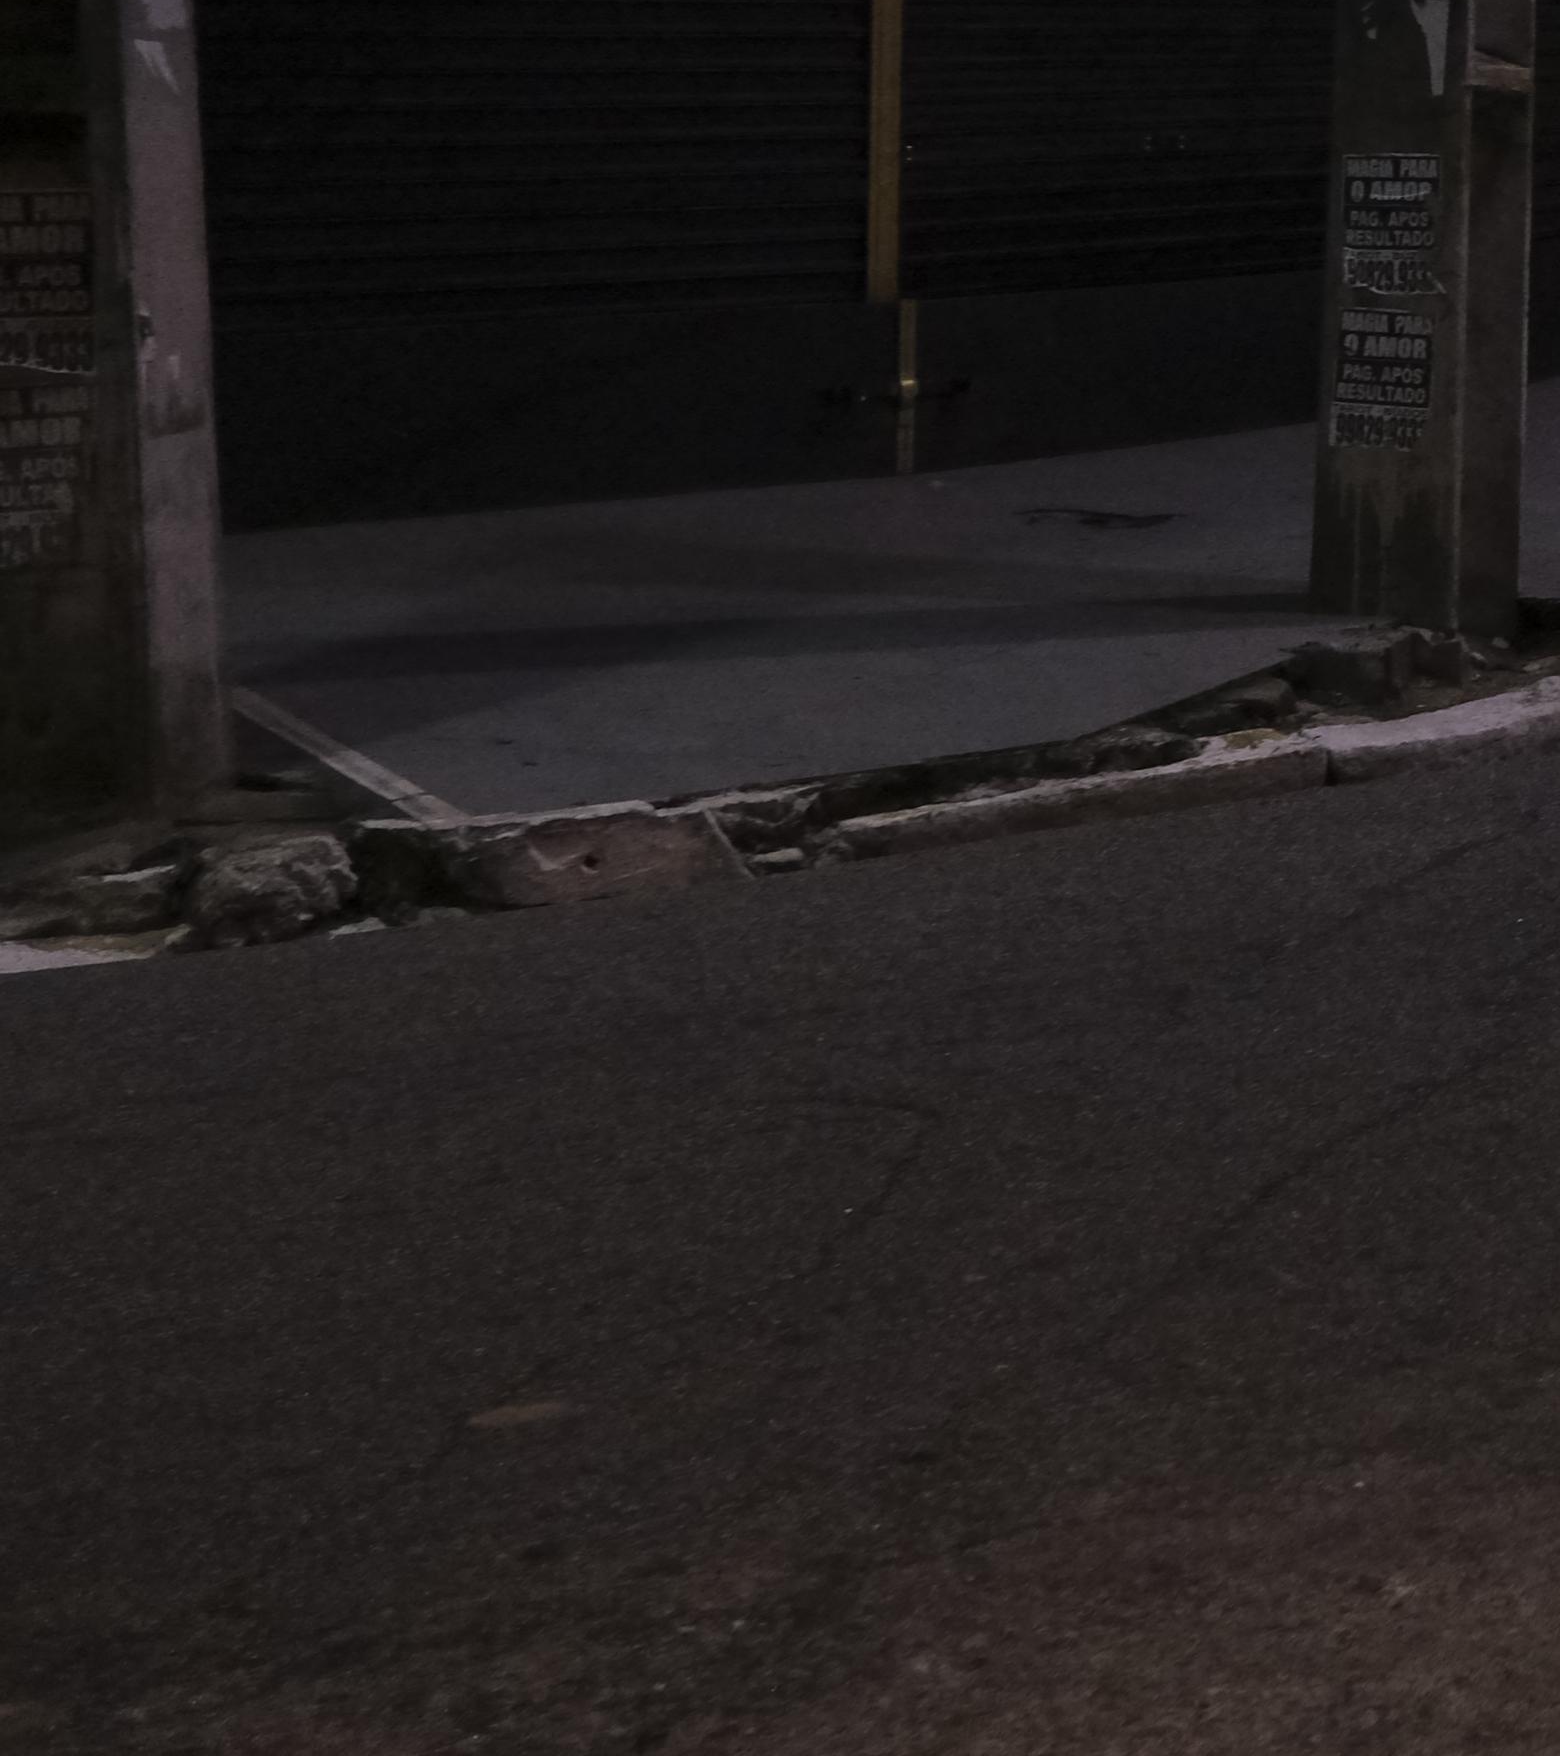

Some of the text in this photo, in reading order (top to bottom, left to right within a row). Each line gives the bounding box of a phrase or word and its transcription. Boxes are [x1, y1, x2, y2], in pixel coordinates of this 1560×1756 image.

[1399, 158, 1438, 178] PARA
[1344, 228, 1436, 247] RESULTADO
[1363, 336, 1428, 359] AMOR
[1335, 382, 1425, 405] RESULTADO
